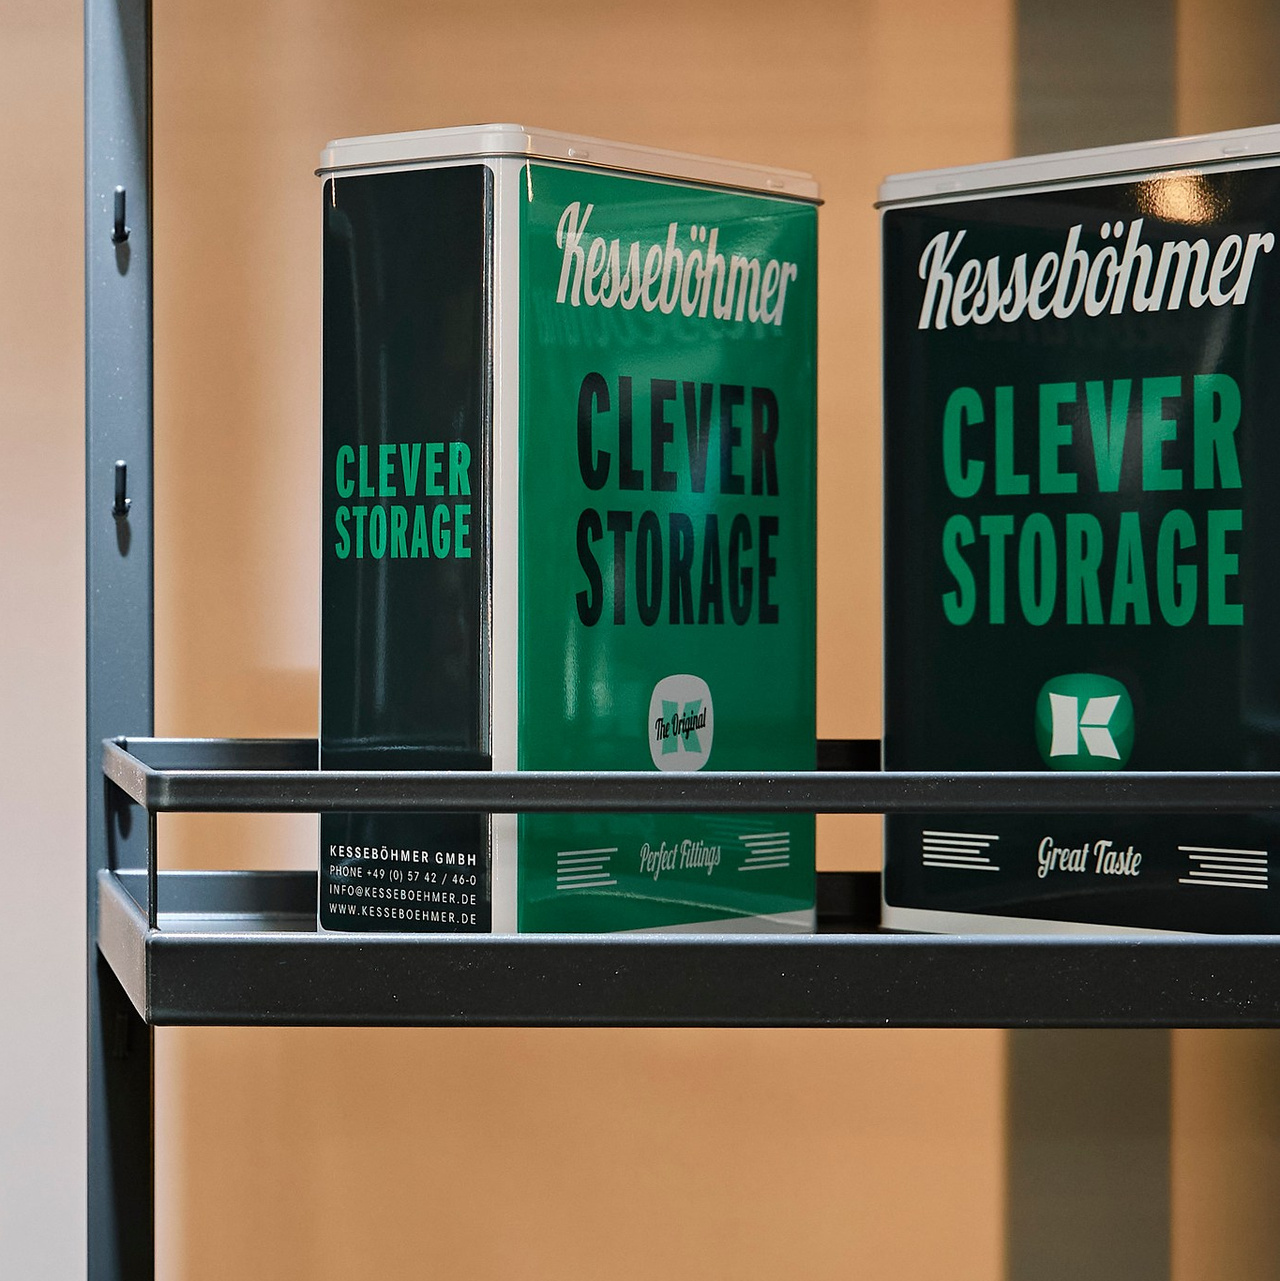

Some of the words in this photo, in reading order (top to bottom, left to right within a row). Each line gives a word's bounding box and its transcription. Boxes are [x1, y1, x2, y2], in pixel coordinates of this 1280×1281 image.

[555, 201, 797, 326] Kesseböhmer
[918, 218, 1275, 330] Kesseböhmer
[576, 371, 779, 497] CLEVER
[942, 373, 1243, 499] CLEVER
[335, 441, 472, 497] CLEVER
[335, 503, 472, 560] STORAGE
[575, 507, 780, 628] STORAGE
[942, 508, 1244, 628] STORAGE
[655, 717, 670, 741] The
[672, 707, 707, 740] Original
[329, 845, 429, 864] KESSEBÖHMER
[435, 852, 477, 866] GMBH
[329, 865, 363, 878] PHONE
[367, 869, 385, 879] +49
[389, 869, 403, 882] (0)
[407, 871, 420, 882] 57
[424, 872, 437, 883] 42
[640, 840, 678, 881] Perfect
[680, 839, 721, 876] Fittings
[1037, 836, 1090, 878] Great
[1093, 840, 1142, 876] Taste
[329, 884, 477, 905] INFO@KESSEBOEHMER.DE
[329, 903, 477, 925] WWW.KESSEBOEHMER.DE
